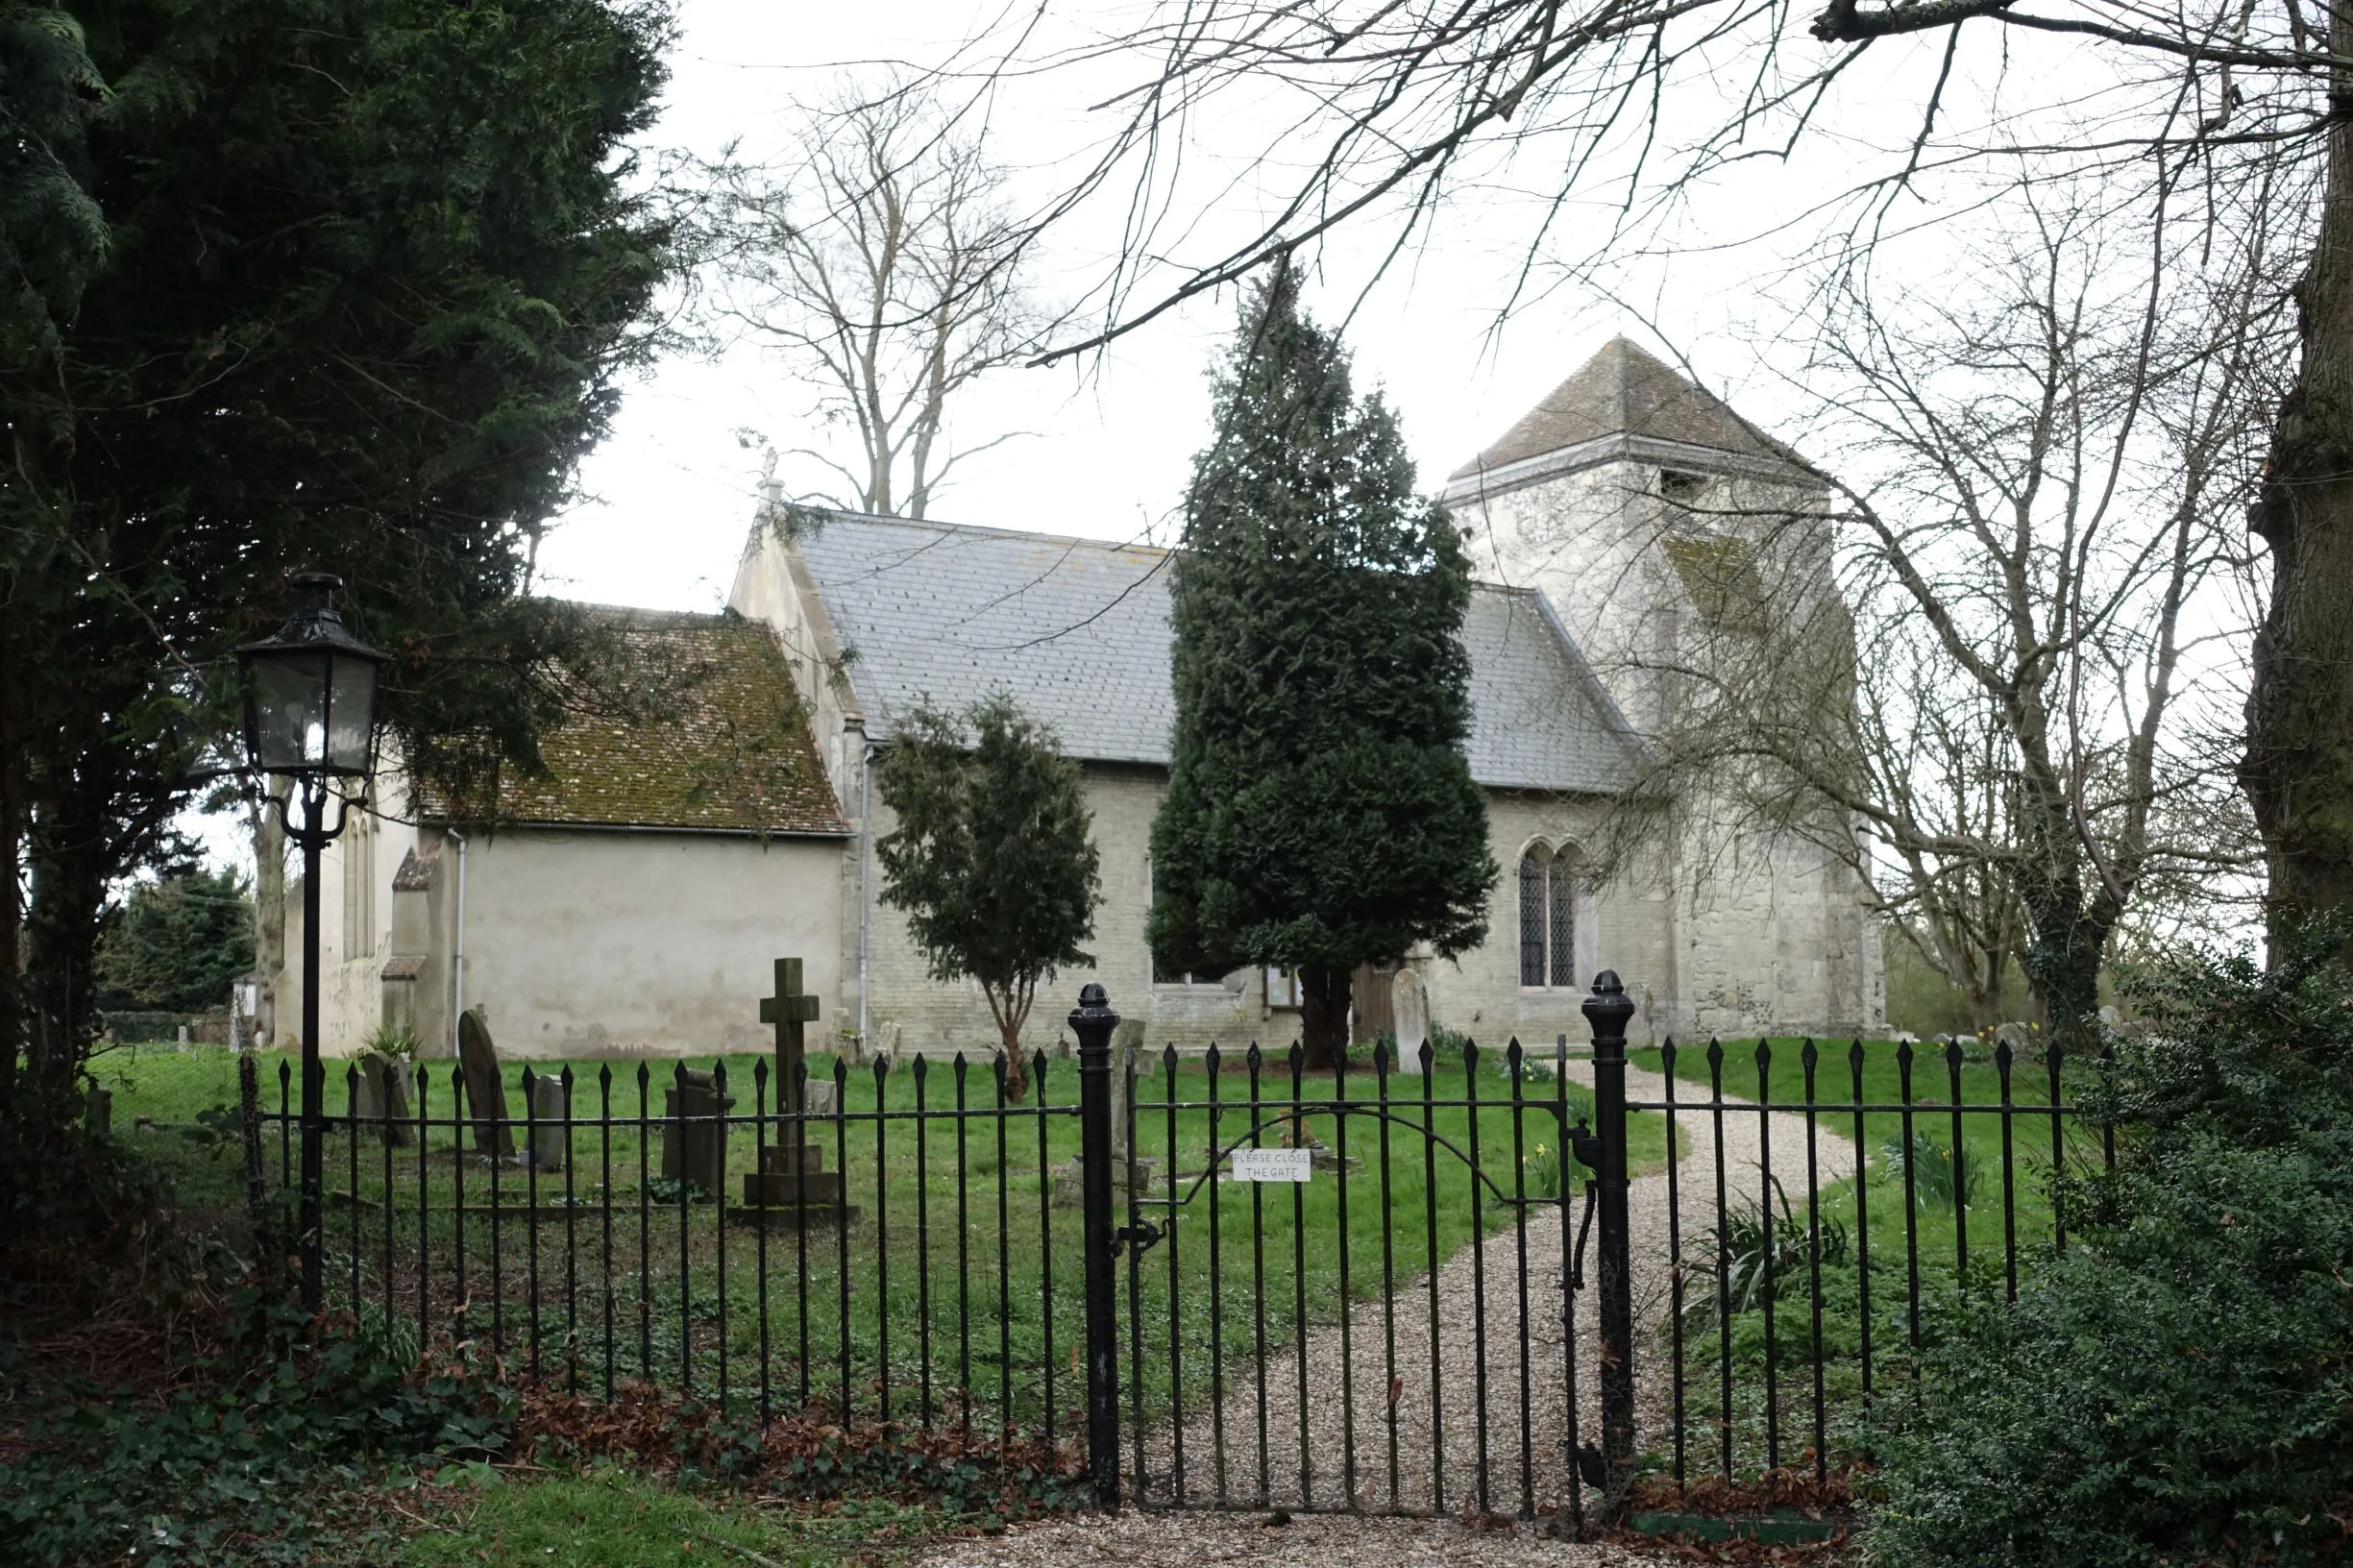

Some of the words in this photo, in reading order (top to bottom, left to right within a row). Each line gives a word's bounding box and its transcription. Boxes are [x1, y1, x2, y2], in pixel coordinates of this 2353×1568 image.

[1234, 1153, 1271, 1164] PLEASE
[1274, 1153, 1309, 1164] CLOSE
[1245, 1167, 1268, 1177] THE
[1270, 1167, 1298, 1178] GATE
